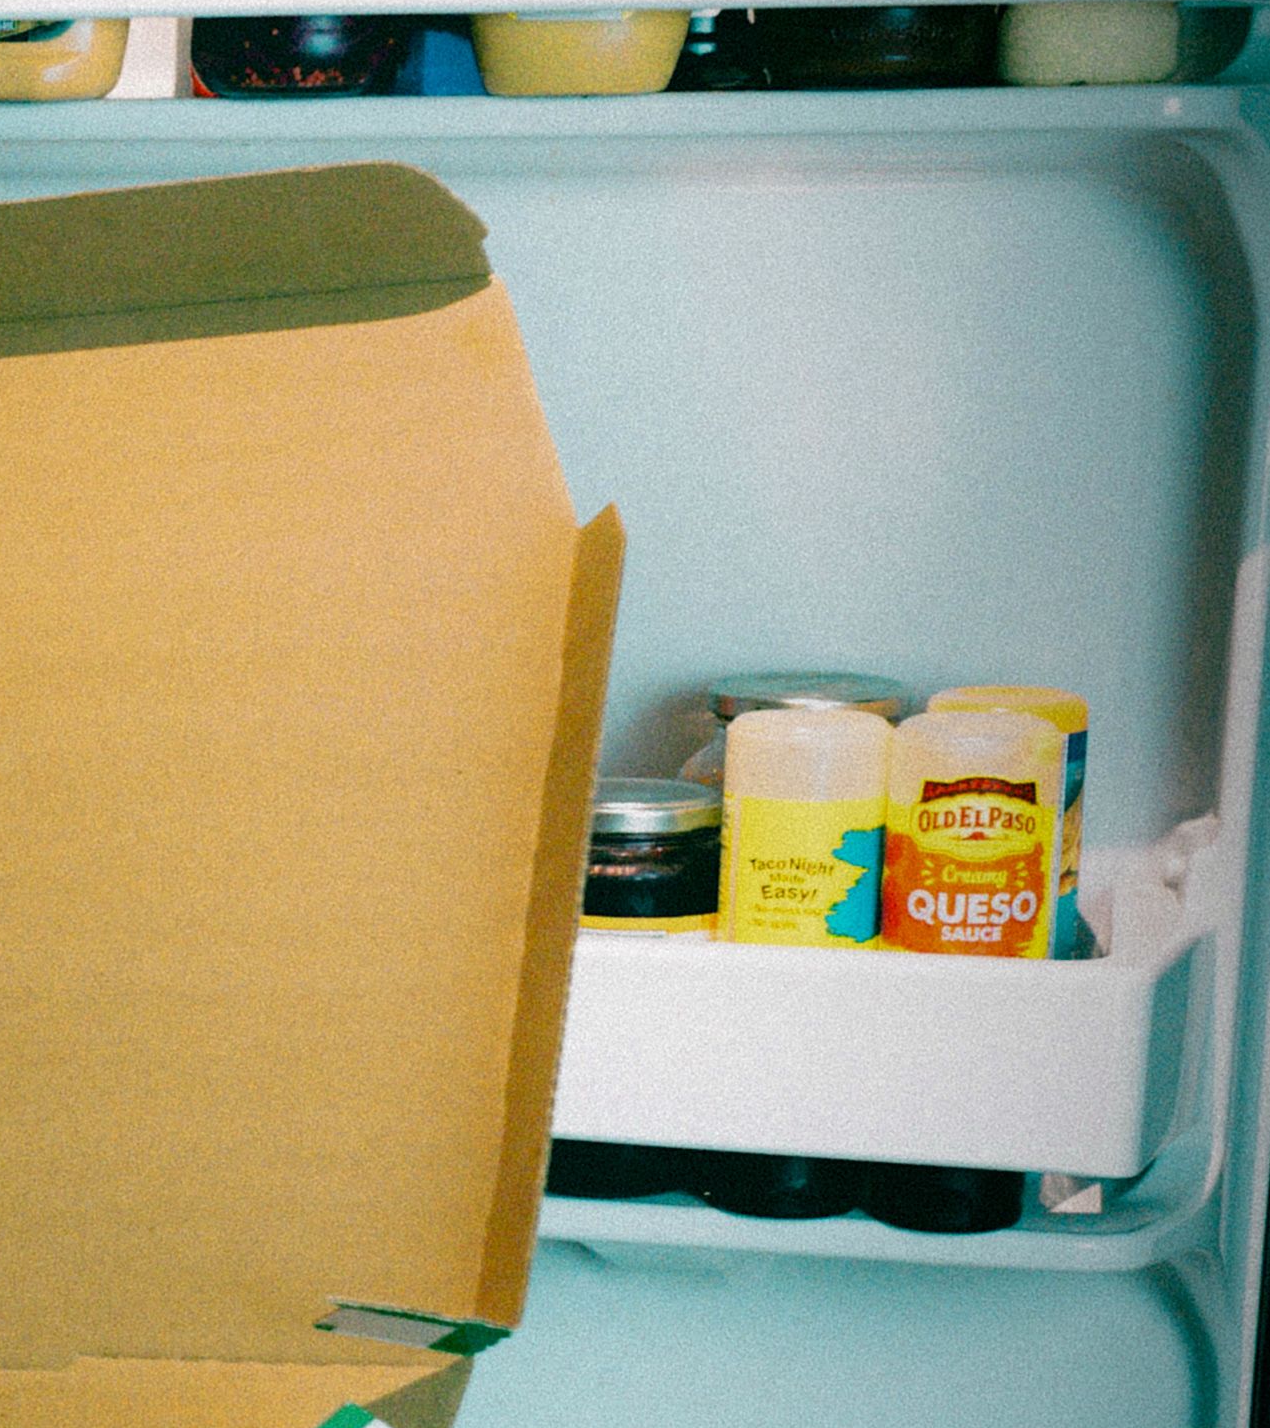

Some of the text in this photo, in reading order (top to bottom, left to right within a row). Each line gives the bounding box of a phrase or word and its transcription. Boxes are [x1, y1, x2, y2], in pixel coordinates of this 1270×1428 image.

[750, 857, 835, 877] Taco Night
[941, 864, 1008, 889] Creamy
[761, 884, 819, 902] Easy!
[907, 889, 1038, 925] QUESO
[941, 925, 1002, 942] SAUCE
